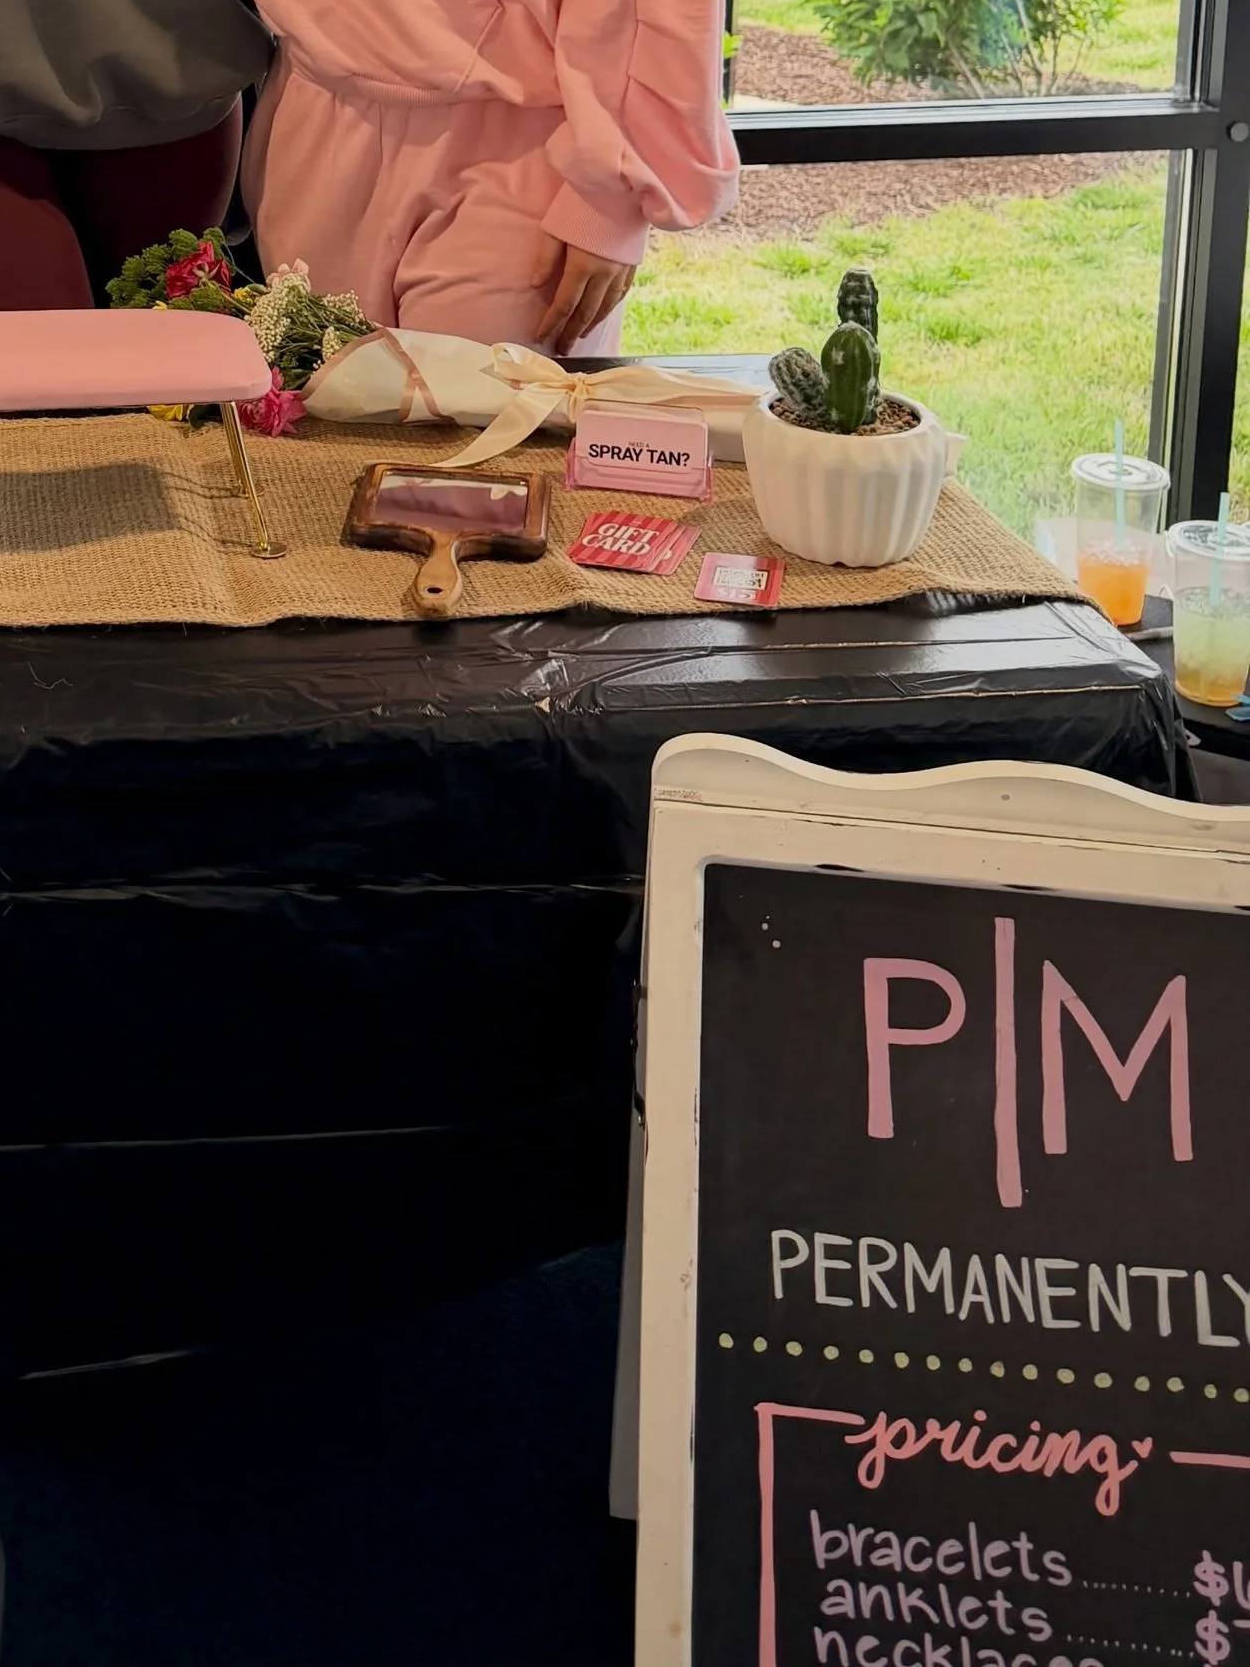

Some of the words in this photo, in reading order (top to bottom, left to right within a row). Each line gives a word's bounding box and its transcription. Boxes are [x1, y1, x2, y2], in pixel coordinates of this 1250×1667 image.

[588, 443, 643, 462] SPRAY
[646, 449, 690, 467] TAN?
[581, 533, 651, 555] CARD
[597, 523, 660, 544] GIFT
[771, 1228, 1250, 1347] PERMANENTLY
[844, 1409, 1138, 1516] pricing
[810, 1509, 1073, 1586] bracelets
[819, 1577, 1053, 1643] anklets
[813, 1625, 1104, 1667] neckl
